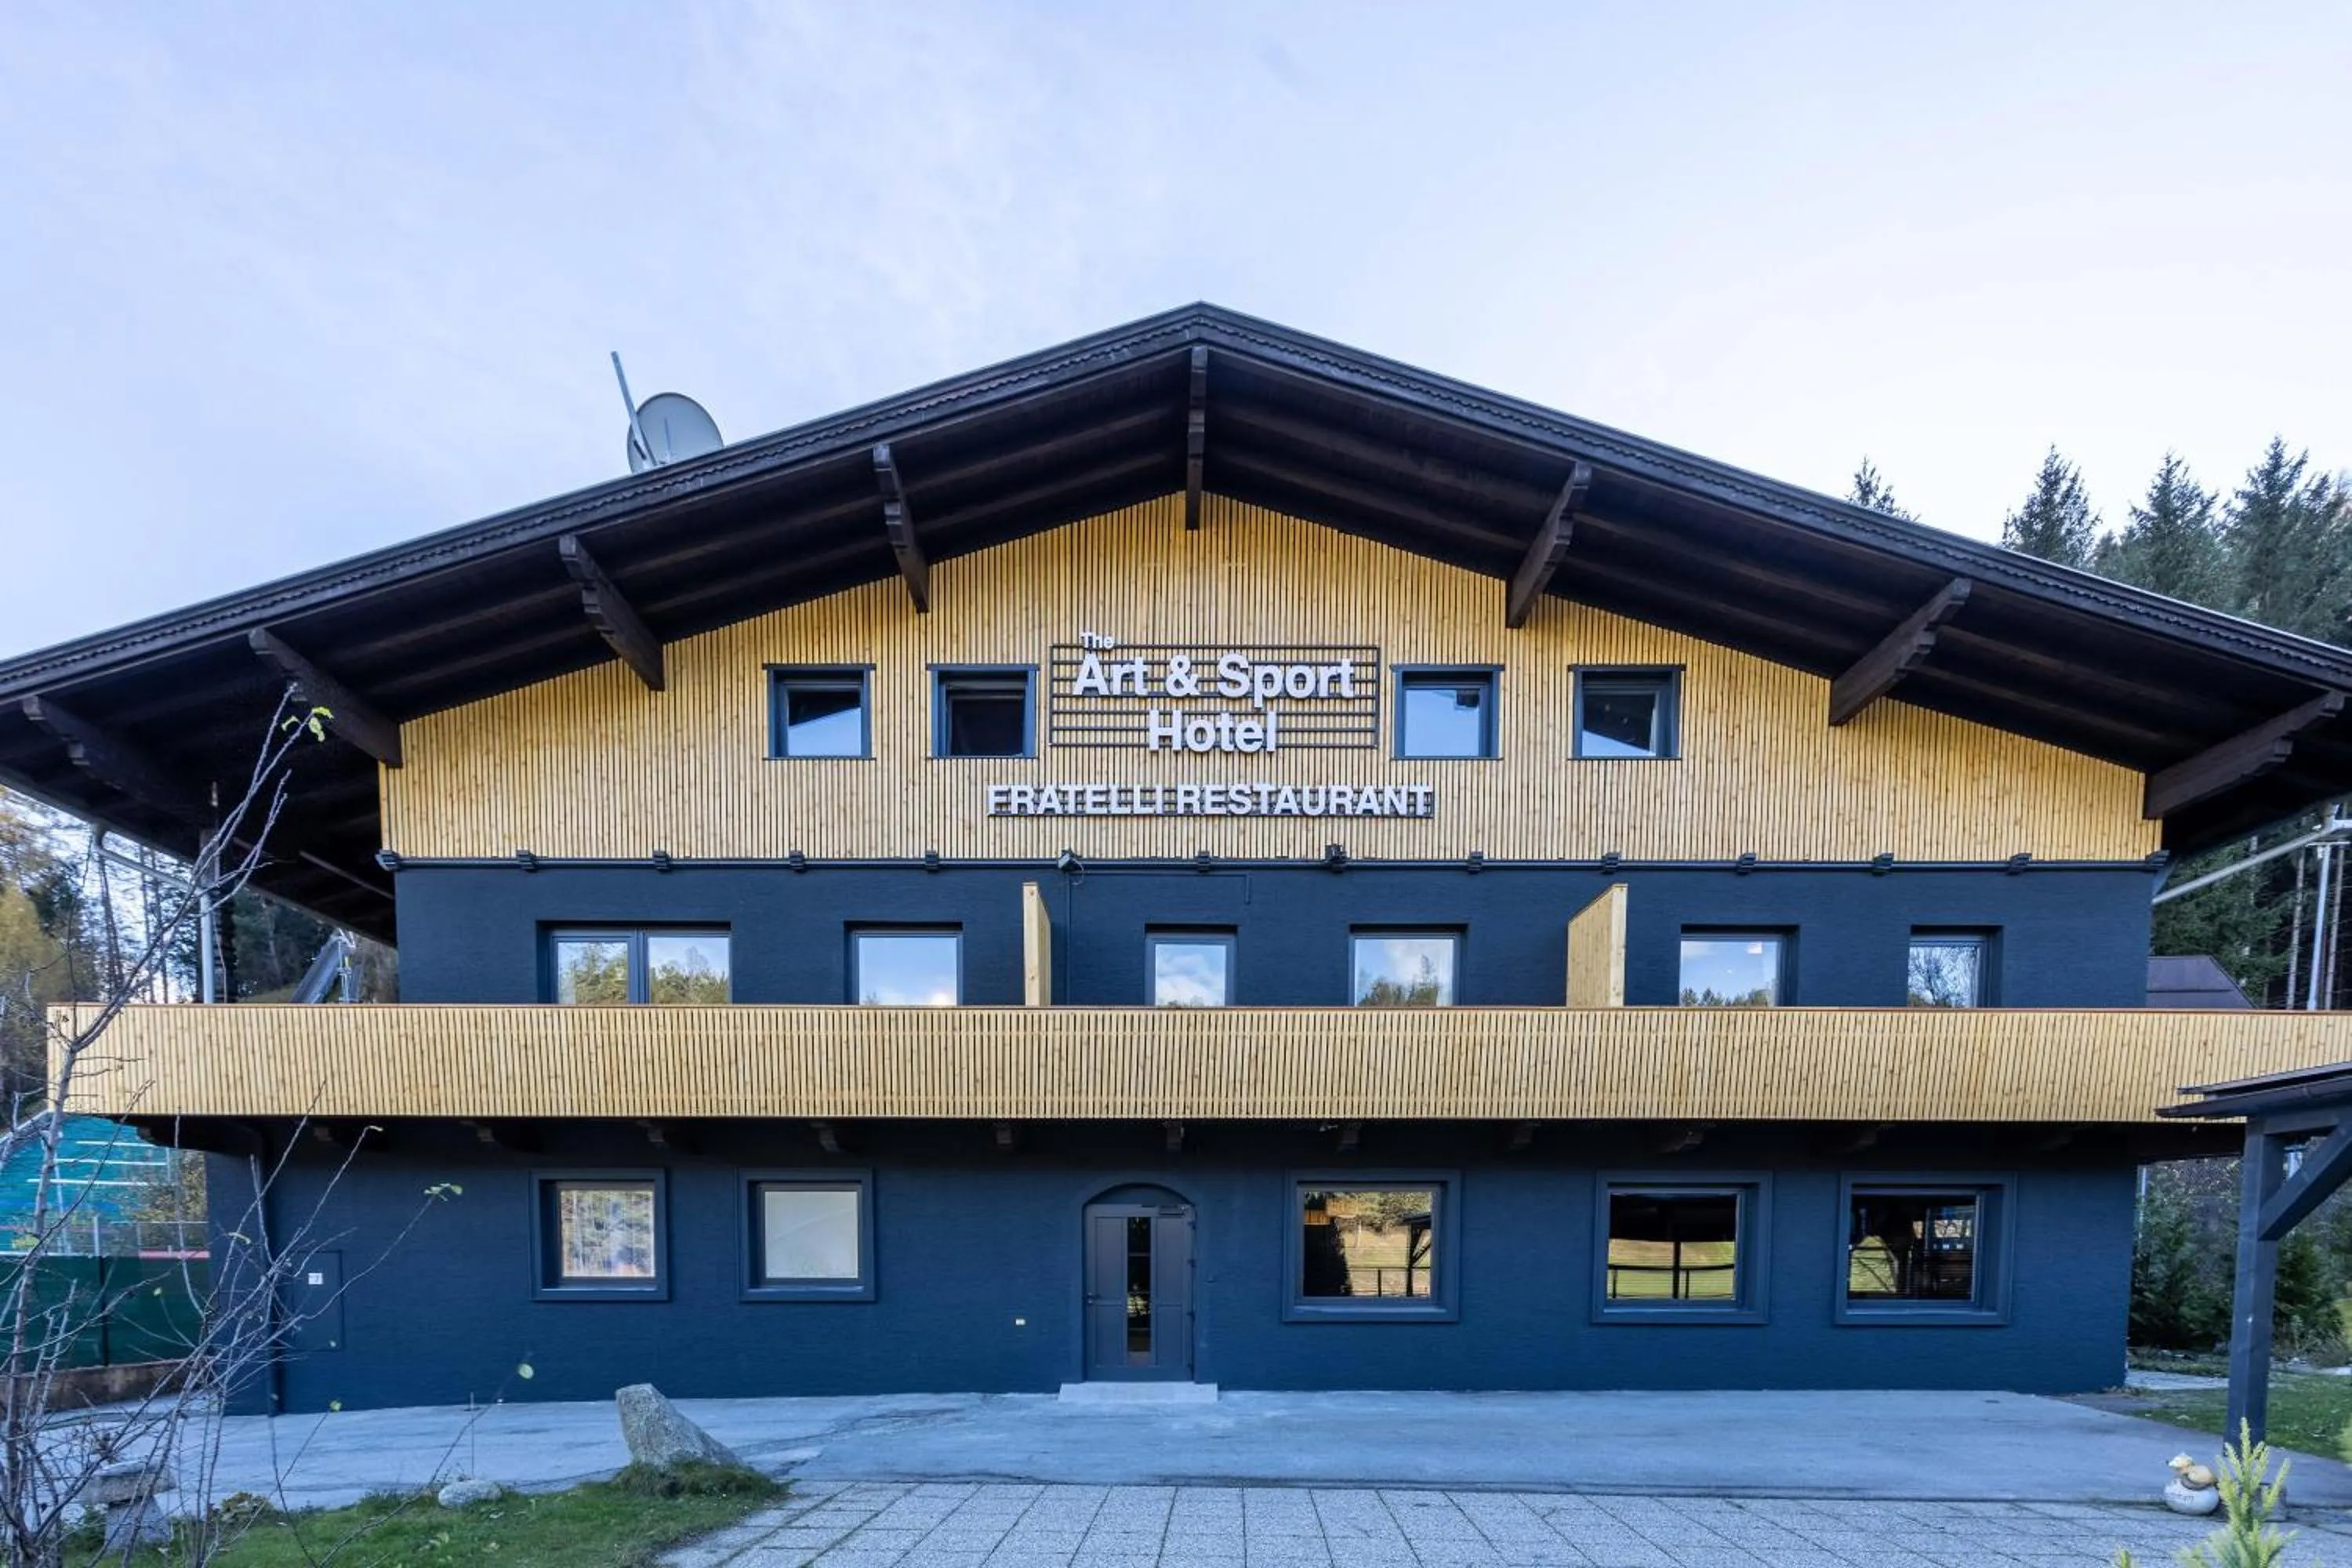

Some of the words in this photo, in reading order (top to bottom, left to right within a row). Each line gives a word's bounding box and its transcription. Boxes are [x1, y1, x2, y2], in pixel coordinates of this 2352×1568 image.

[1081, 631, 1114, 649] The
[1072, 653, 1149, 696] Art
[1167, 655, 1200, 697] &
[1217, 653, 1354, 708] Sport
[1149, 710, 1276, 753] Hotel
[988, 784, 1163, 815] FRATELLI
[1177, 784, 1432, 816] RESTAURANT
